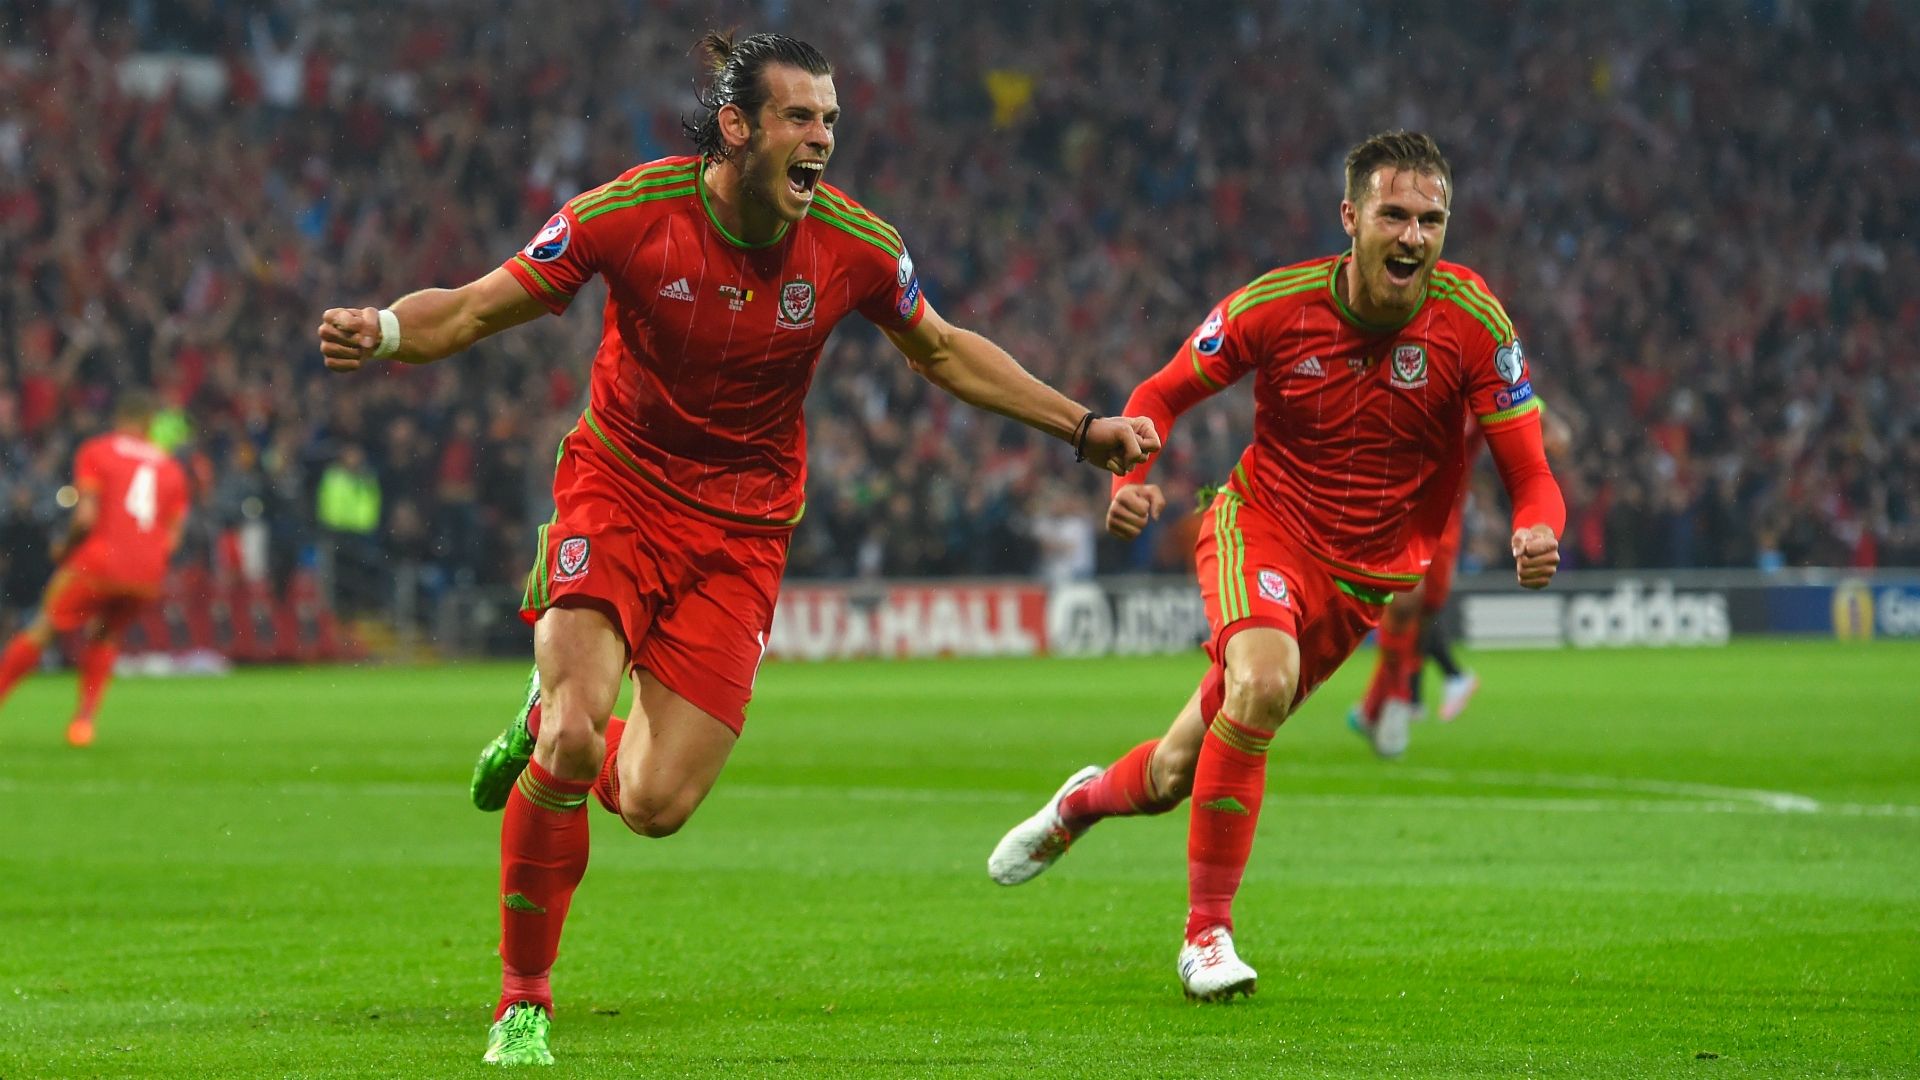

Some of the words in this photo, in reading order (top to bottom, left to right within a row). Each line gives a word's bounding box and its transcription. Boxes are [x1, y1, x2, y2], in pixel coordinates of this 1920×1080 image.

[659, 289, 695, 302] adidas
[124, 463, 157, 533] 4
[767, 588, 1040, 658] AUXHALL
